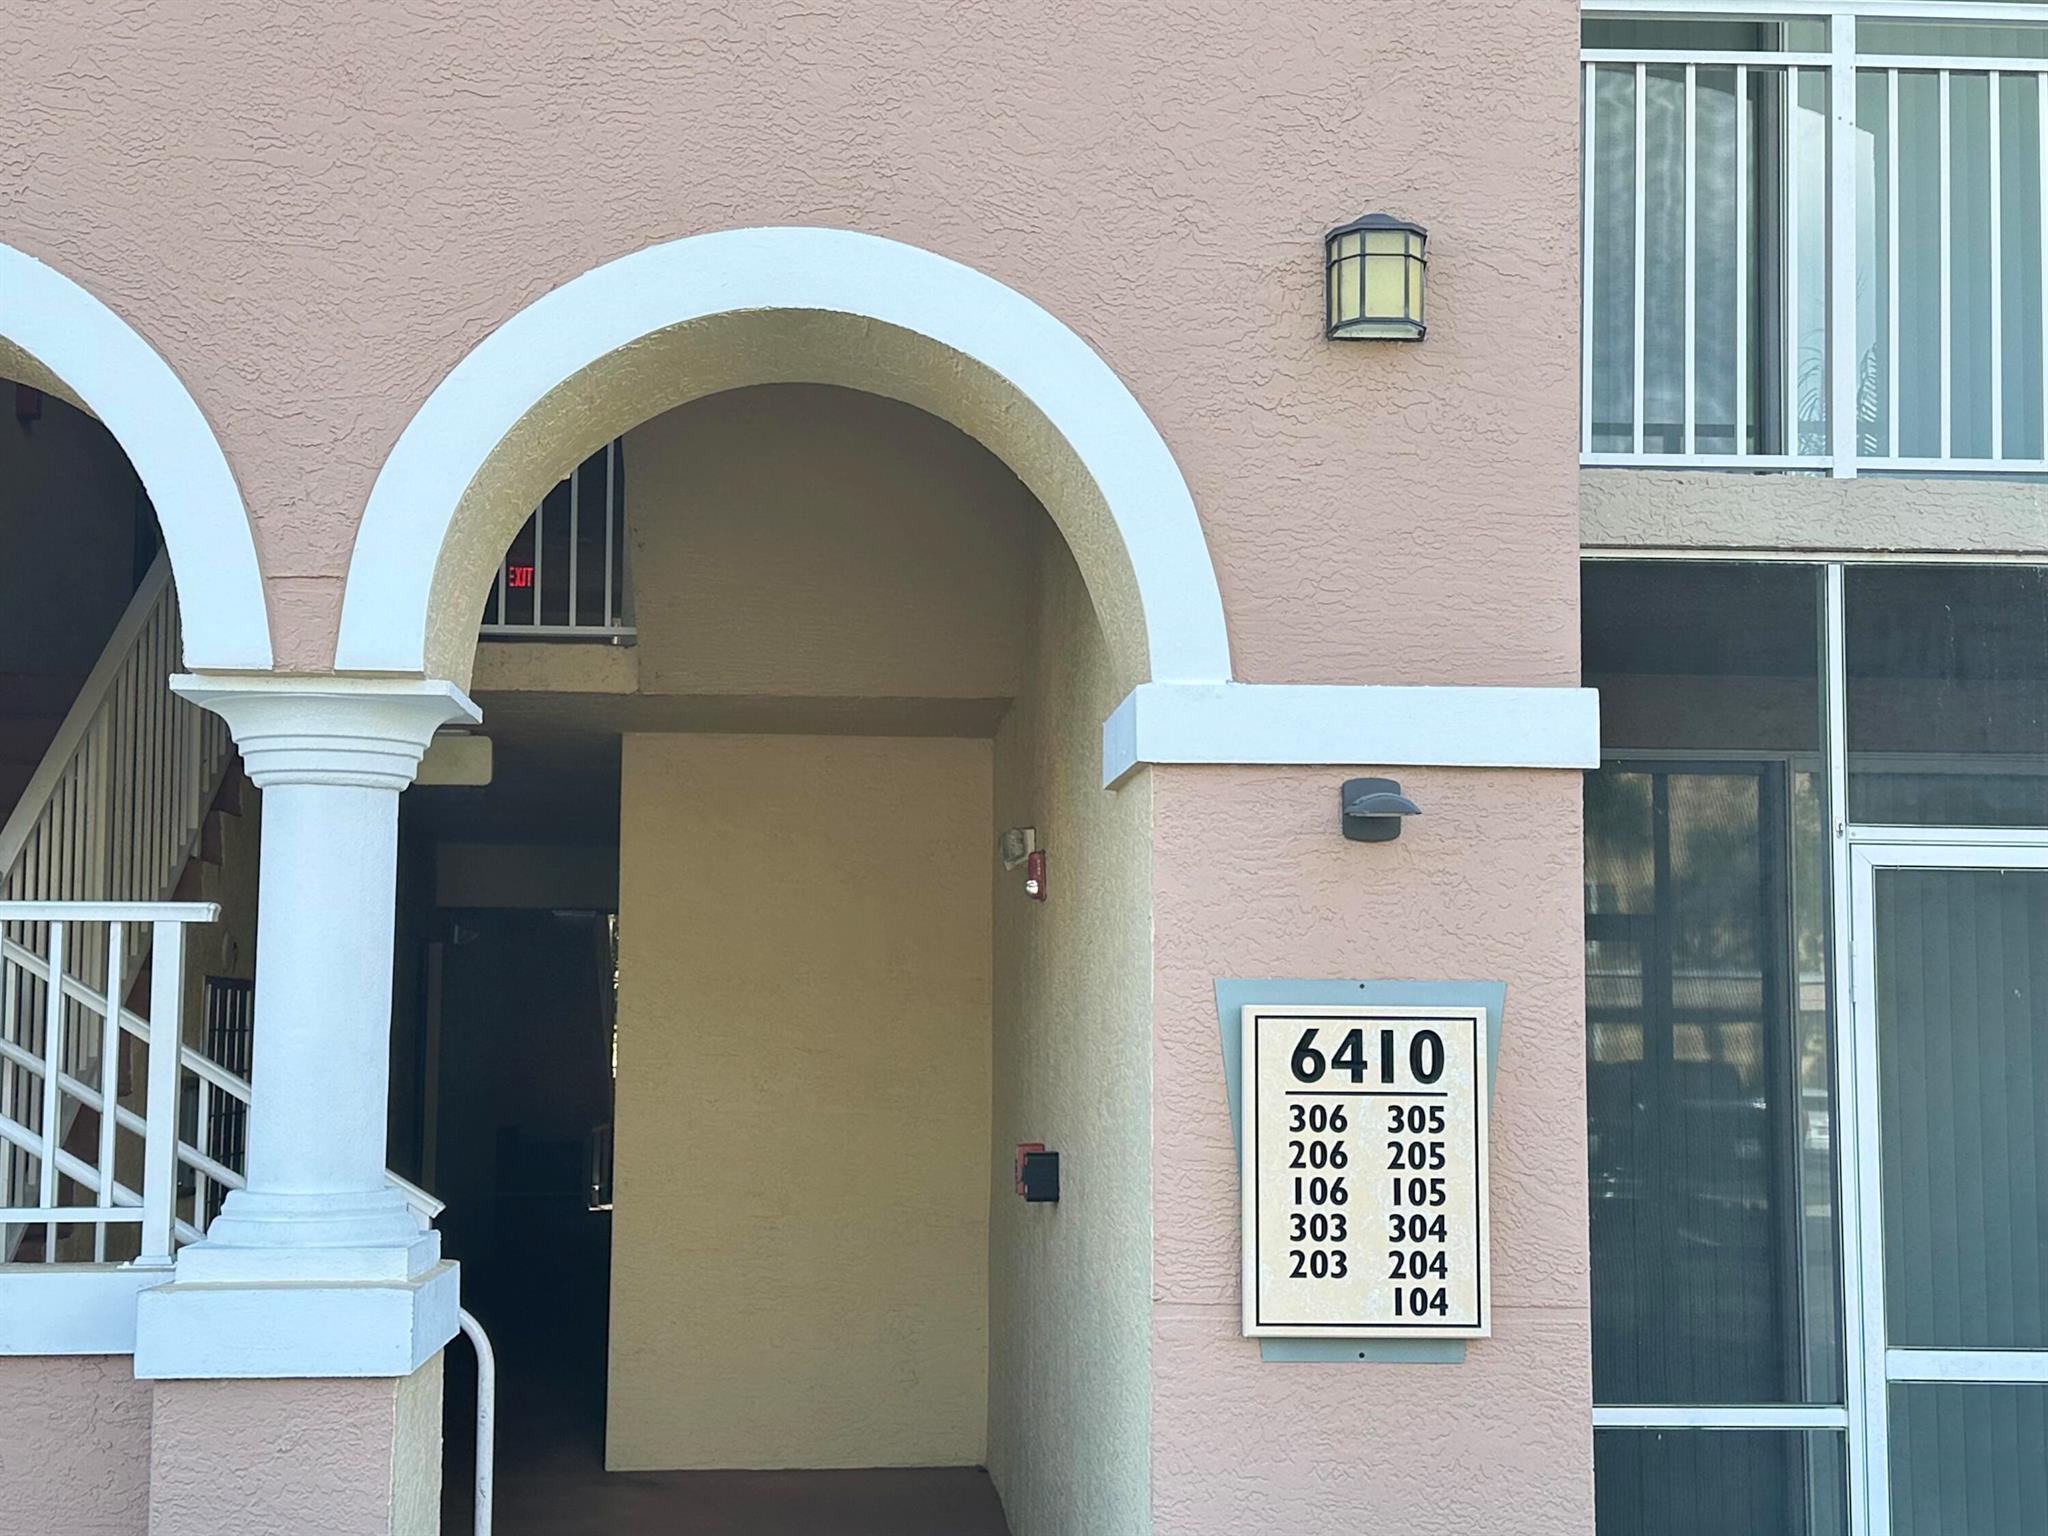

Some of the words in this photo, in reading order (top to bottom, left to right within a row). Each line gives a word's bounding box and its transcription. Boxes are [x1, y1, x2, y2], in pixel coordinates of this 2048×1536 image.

[509, 567, 534, 587] EXIT
[1291, 1028, 1445, 1084] 6410
[1289, 1104, 1348, 1133] 306
[1387, 1105, 1445, 1134] 305
[1288, 1141, 1348, 1169] 206
[1387, 1141, 1446, 1170] 205
[1294, 1177, 1349, 1205] 106
[1393, 1177, 1446, 1206] 105
[1289, 1213, 1348, 1242] 303
[1388, 1214, 1448, 1243] 304
[1289, 1250, 1348, 1278] 203
[1388, 1250, 1448, 1279] 204
[1394, 1287, 1449, 1316] 104
